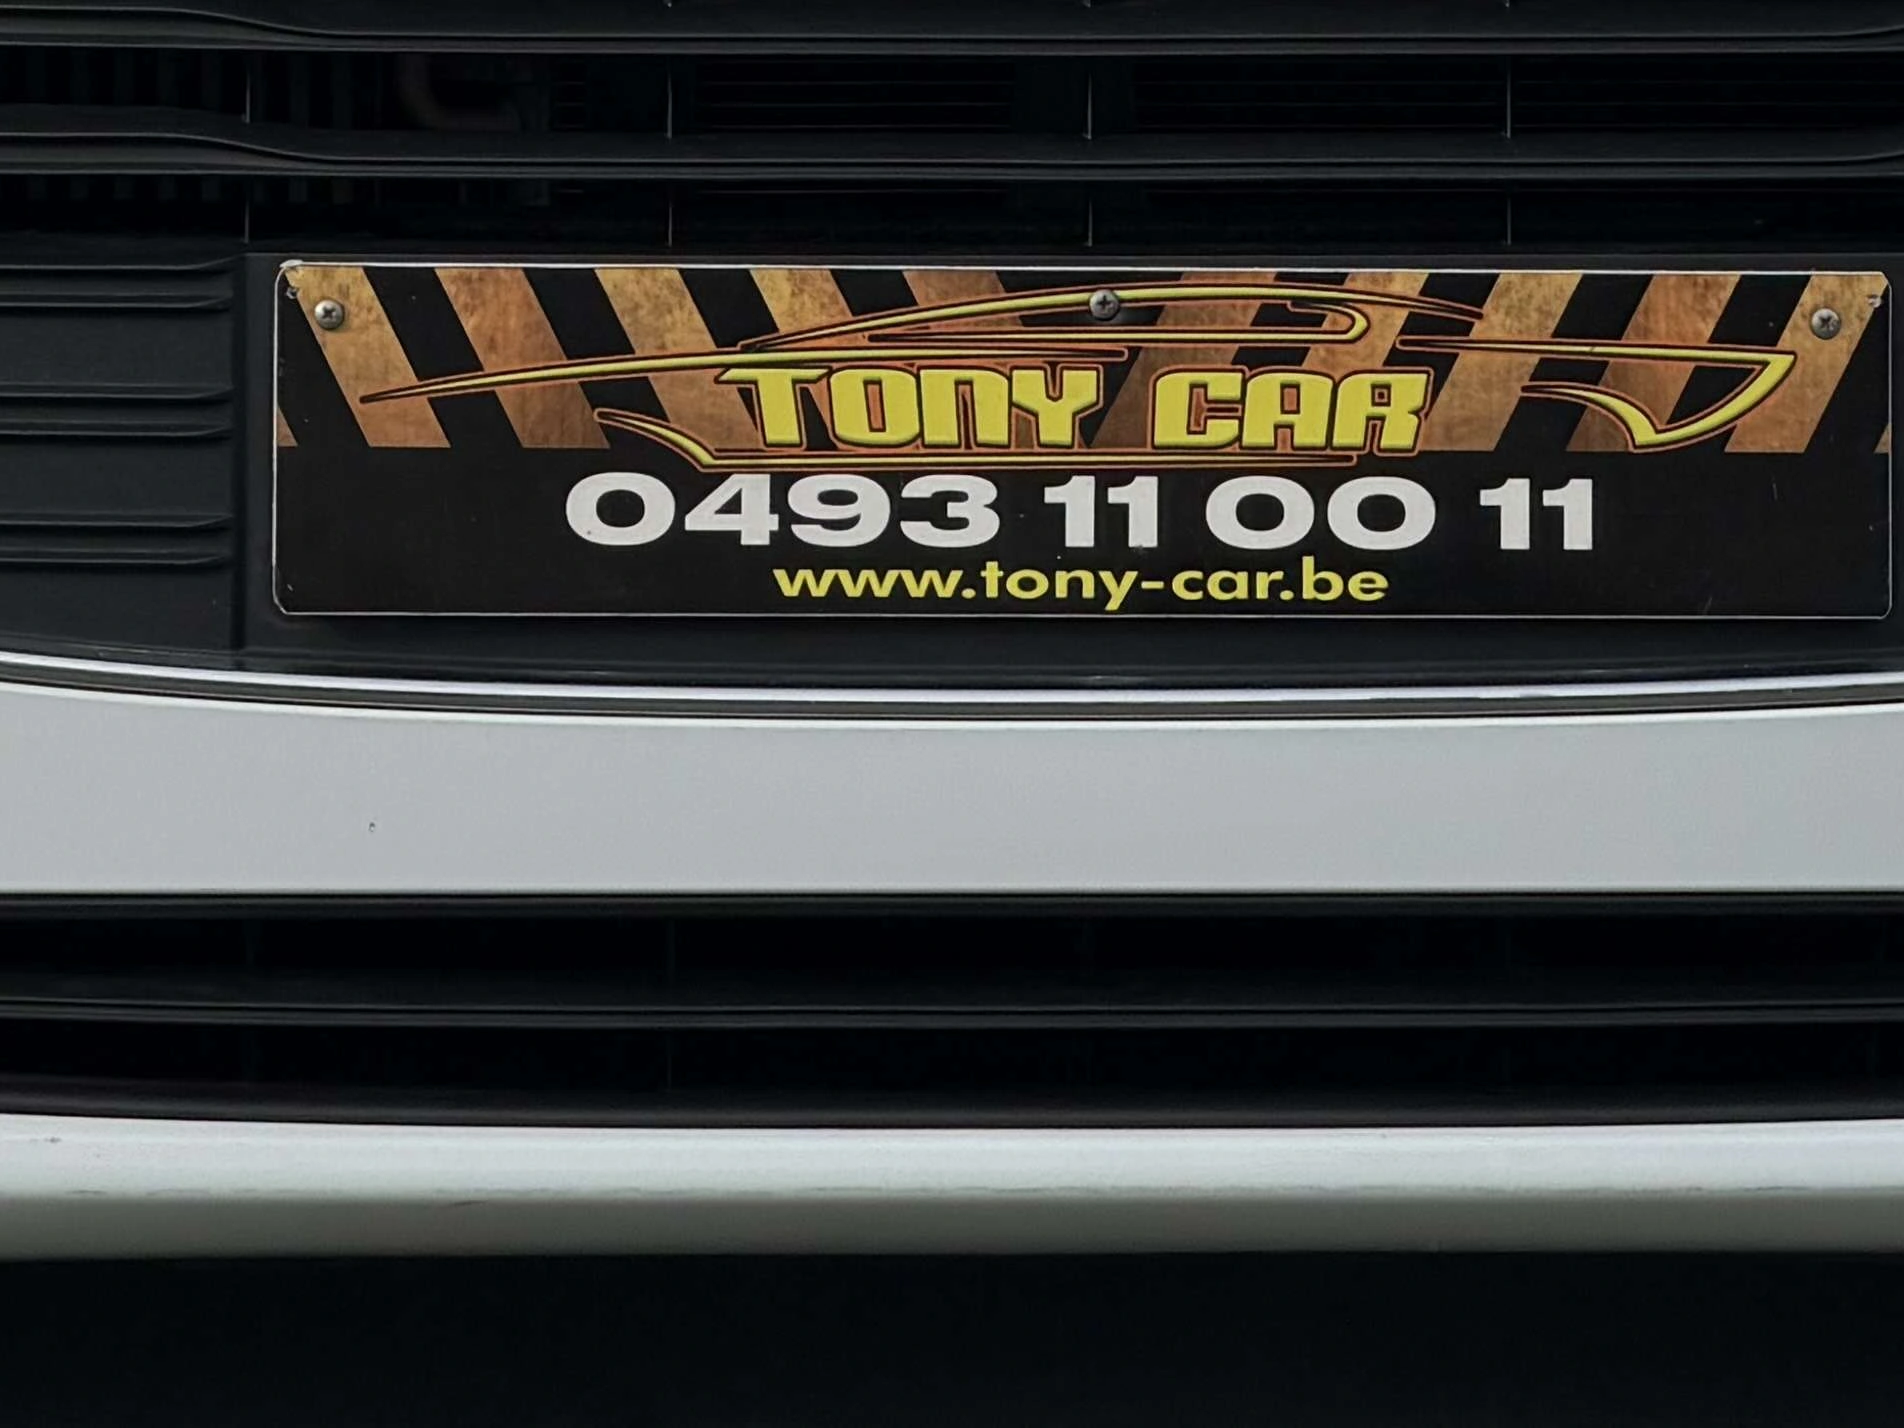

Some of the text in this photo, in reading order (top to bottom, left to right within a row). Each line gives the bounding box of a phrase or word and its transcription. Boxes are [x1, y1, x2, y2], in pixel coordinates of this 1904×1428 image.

[716, 366, 1432, 452] TONY CAR
[565, 471, 1593, 551] 0493 11 00 11
[772, 554, 1390, 612] www.tony-car.be
